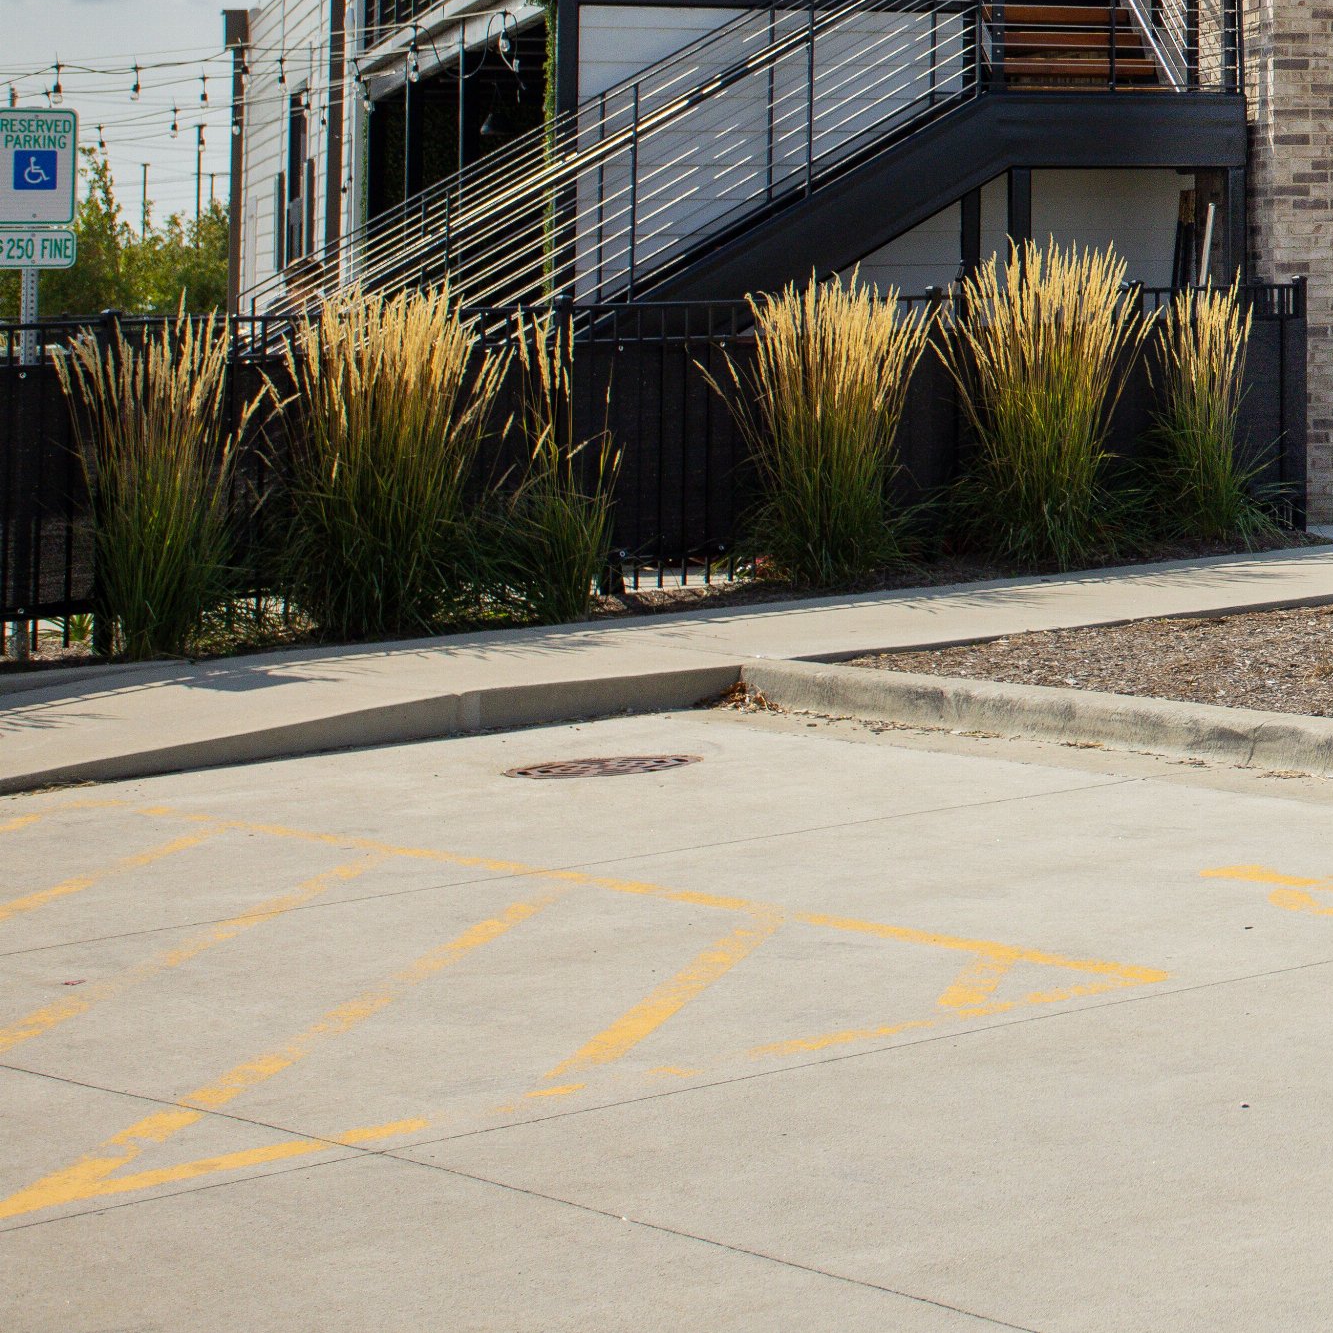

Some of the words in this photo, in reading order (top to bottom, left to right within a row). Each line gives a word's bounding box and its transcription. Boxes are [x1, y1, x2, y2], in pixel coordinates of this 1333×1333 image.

[0, 118, 72, 134] RESERVED
[4, 135, 67, 149] PARKING
[41, 238, 73, 259] FINE
